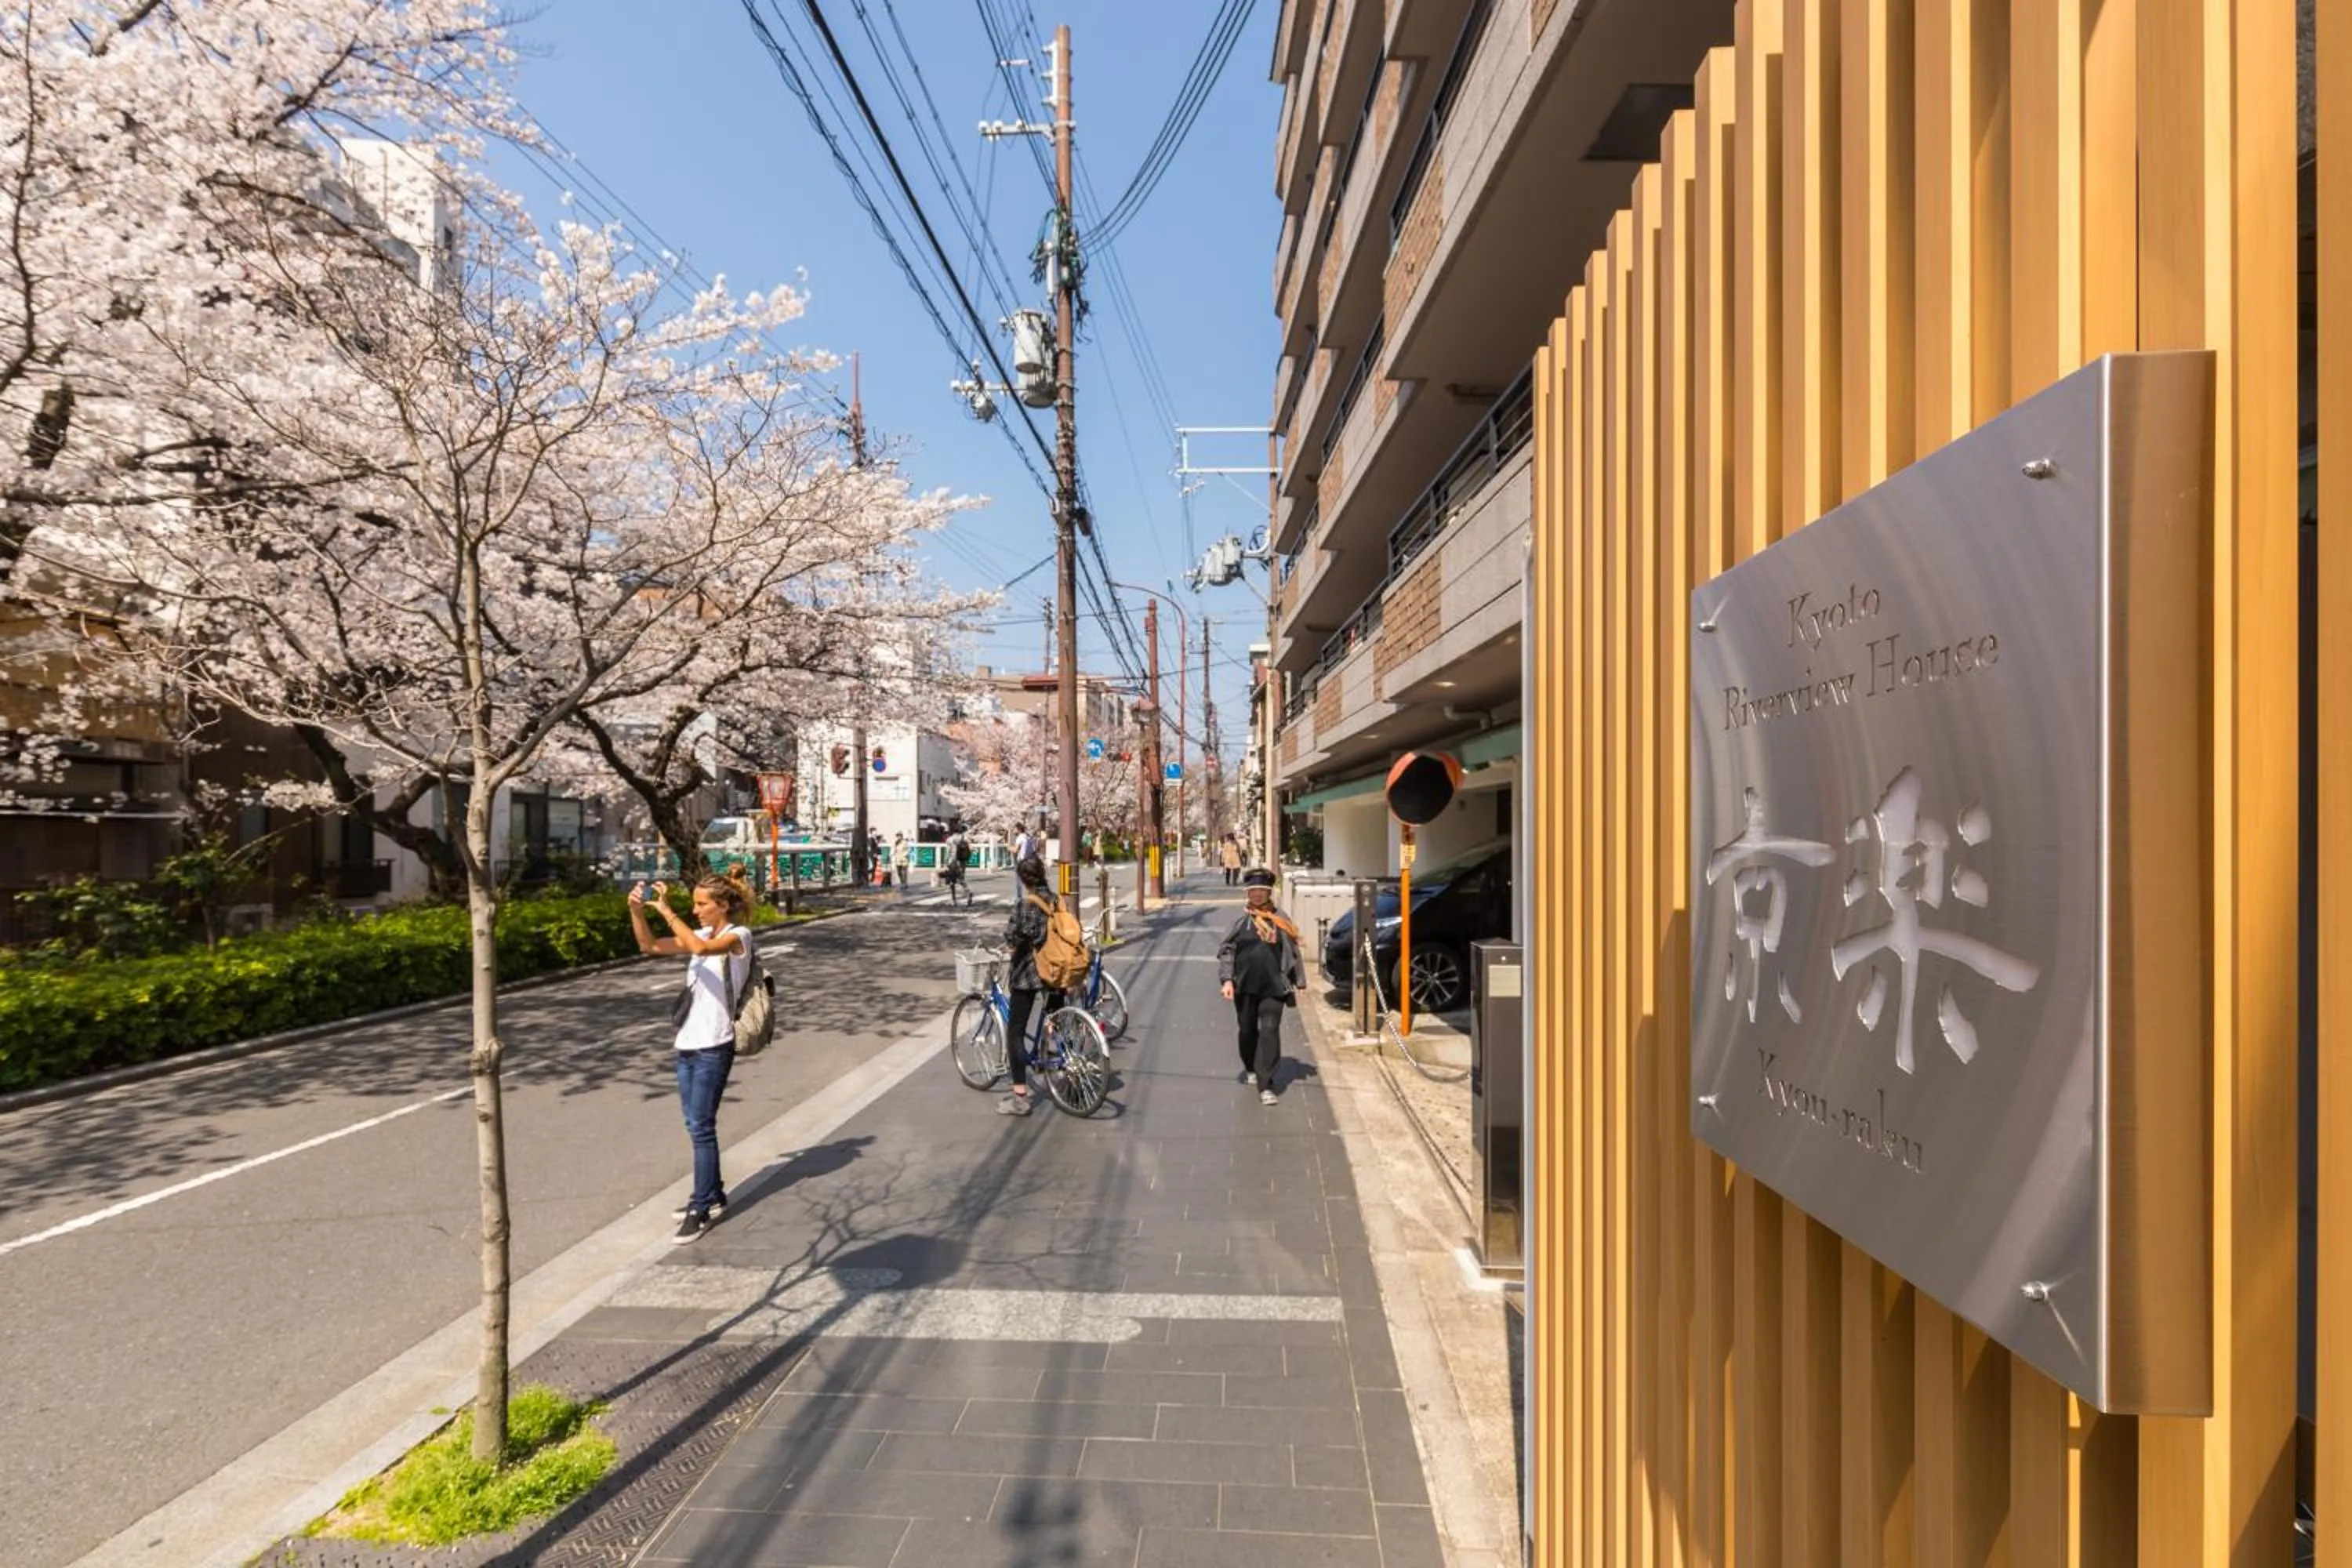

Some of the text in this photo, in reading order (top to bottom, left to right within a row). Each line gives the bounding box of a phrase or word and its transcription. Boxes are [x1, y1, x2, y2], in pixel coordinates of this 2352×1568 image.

[1787, 582, 1880, 650] Kyoto
[1723, 633, 1998, 730] Riverview House
[1706, 765, 2039, 1075] 京楽
[1756, 1047, 1925, 1174] Kyou-raku
